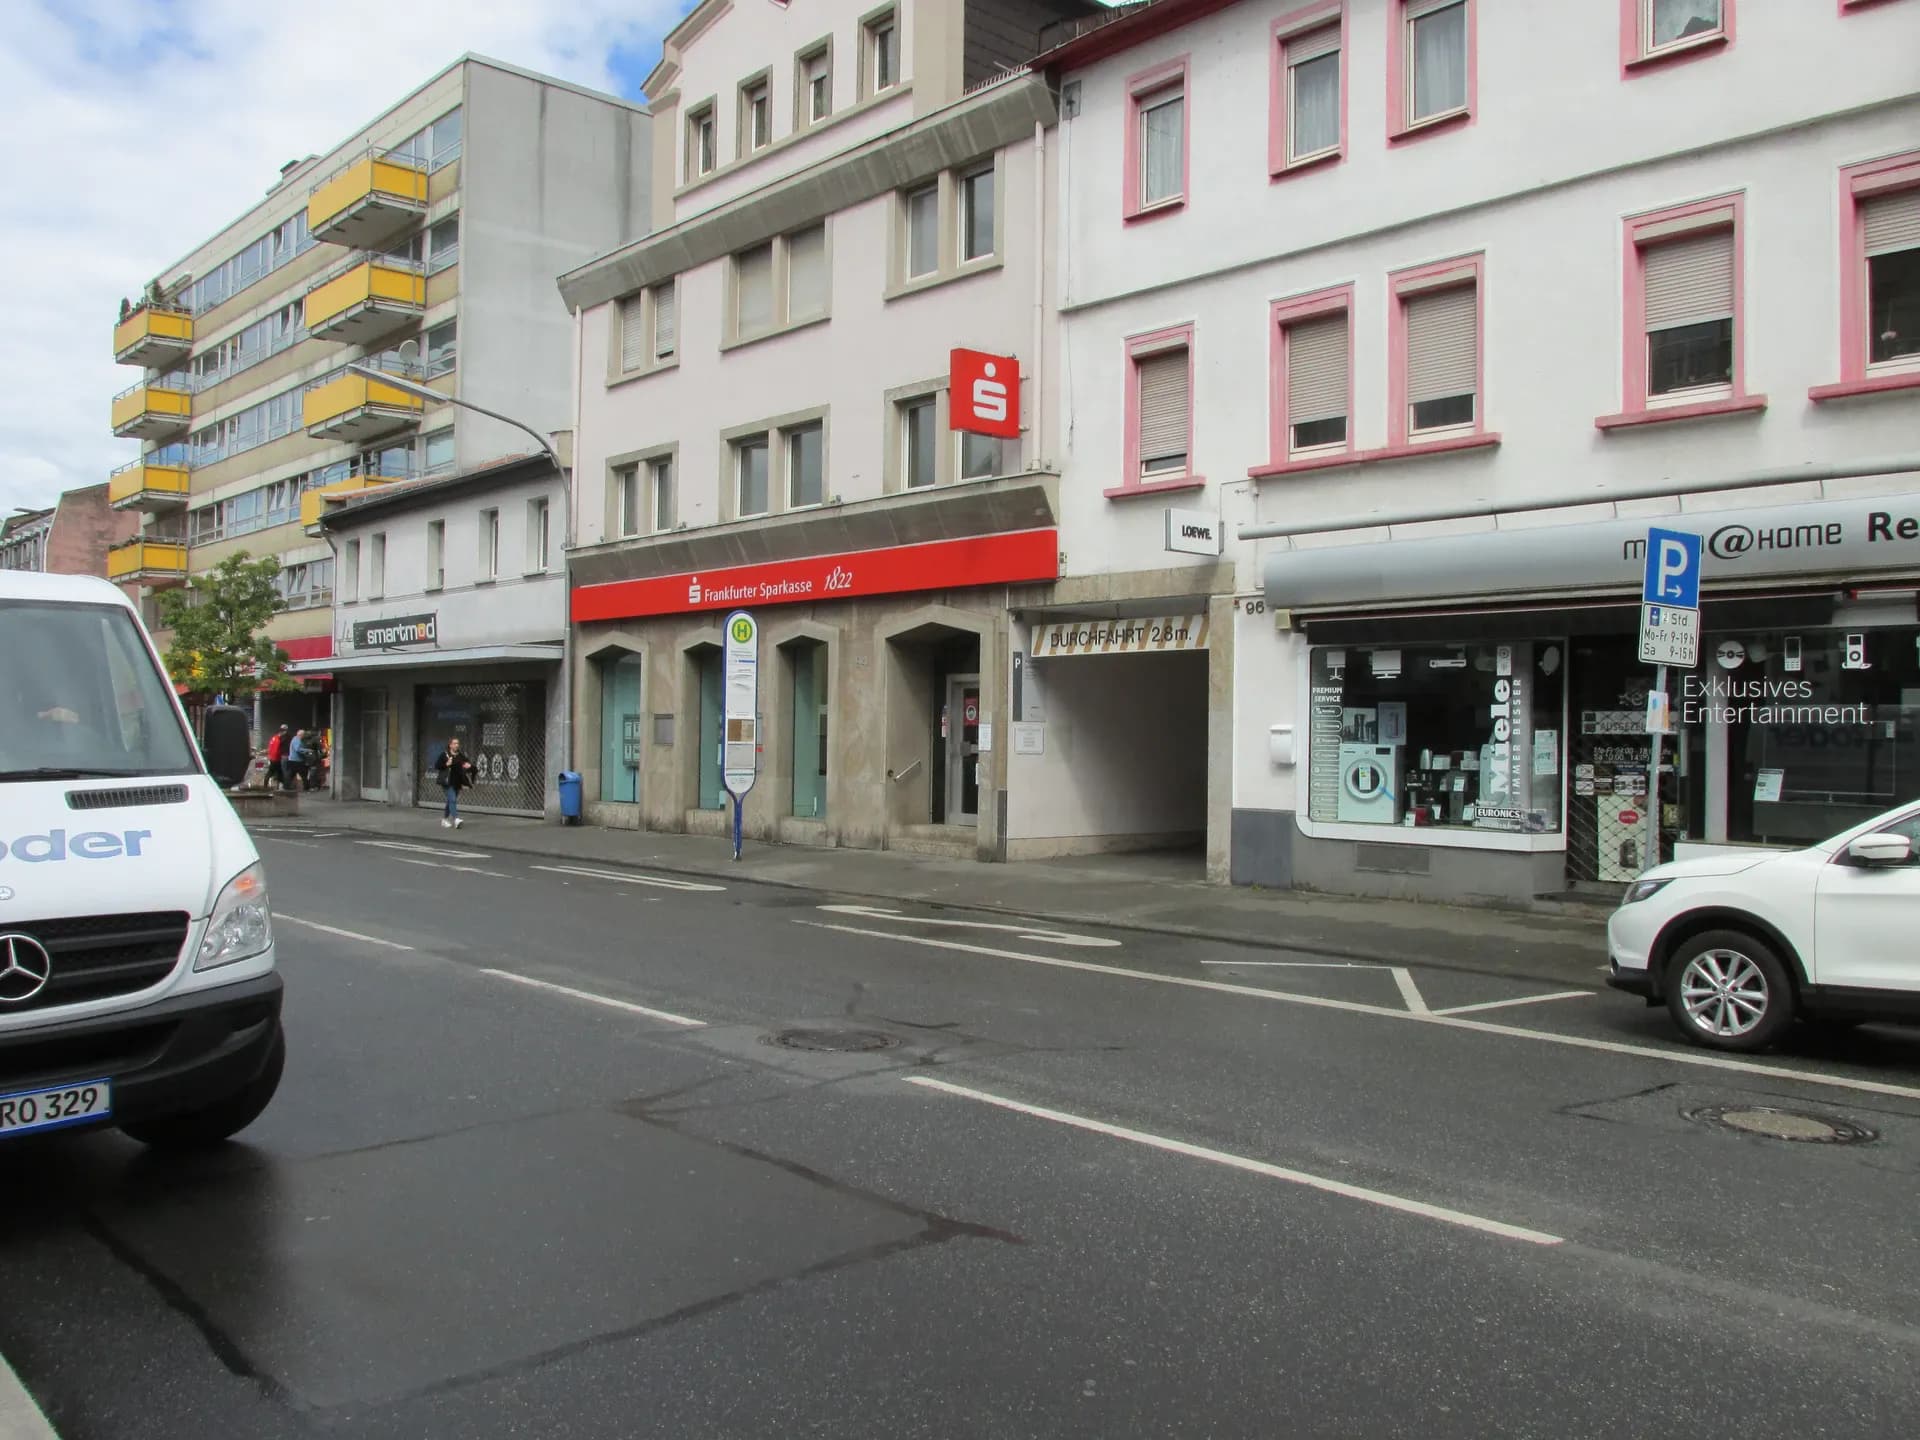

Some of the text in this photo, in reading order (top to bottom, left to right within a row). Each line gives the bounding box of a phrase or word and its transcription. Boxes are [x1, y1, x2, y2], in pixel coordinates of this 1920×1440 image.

[1657, 538, 1688, 597] P
[704, 585, 757, 602] Frankfurter
[759, 580, 813, 599] Sparkasse
[824, 565, 853, 591] 1822
[1246, 600, 1265, 615] 96
[367, 617, 435, 645] smartmod
[737, 623, 748, 639] H
[1050, 627, 1145, 647] DURCHFAHRT
[1644, 628, 1667, 642] Mo-Fr
[1643, 643, 1656, 655] Sa
[1312, 686, 1343, 694] PREMIUM
[1683, 675, 1812, 698] Exklusives
[1683, 701, 1875, 725] Entertainment.
[1490, 679, 1510, 795] Miele
[1512, 679, 1522, 795] IMMER BESSER
[1477, 808, 1520, 818] EURONICS
[0, 828, 152, 863] der
[45, 1087, 98, 1121] 329
